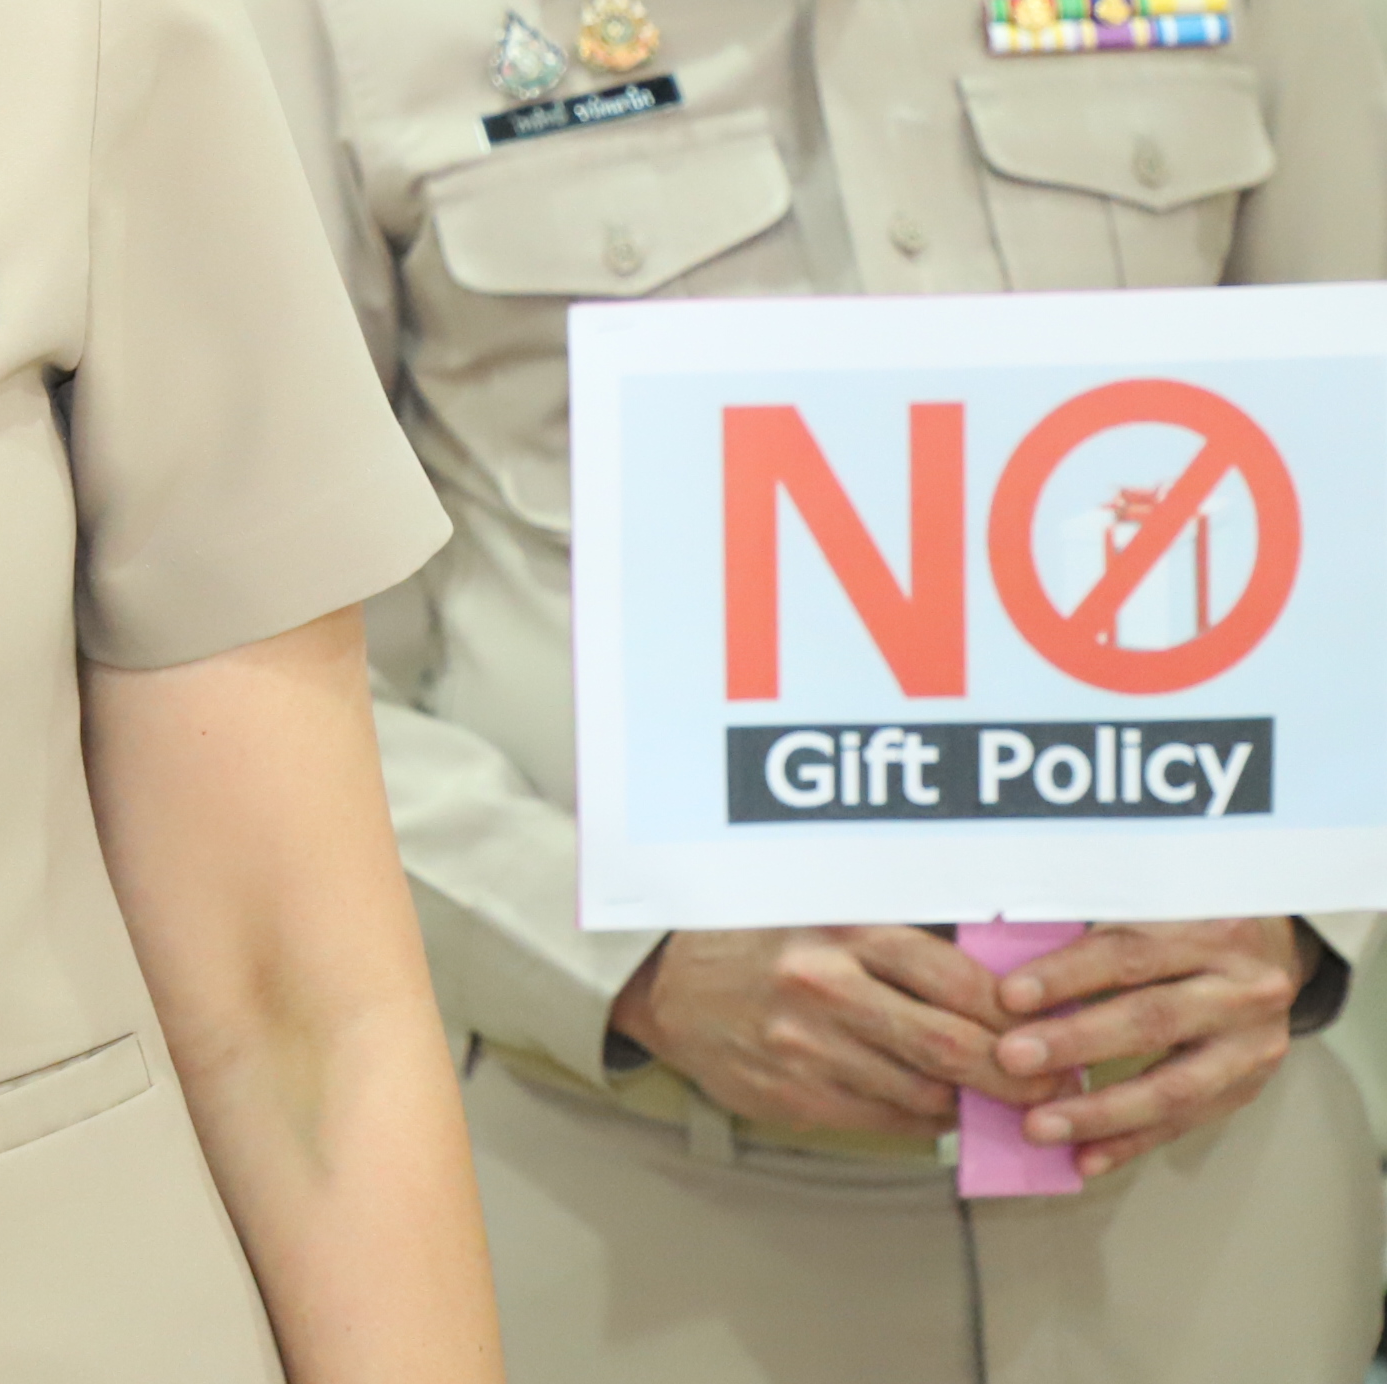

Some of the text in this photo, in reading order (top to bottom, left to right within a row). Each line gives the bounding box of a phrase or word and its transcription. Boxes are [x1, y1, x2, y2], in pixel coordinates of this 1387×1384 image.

[722, 378, 1302, 700] NO
[764, 727, 1253, 817] Gift Policy
